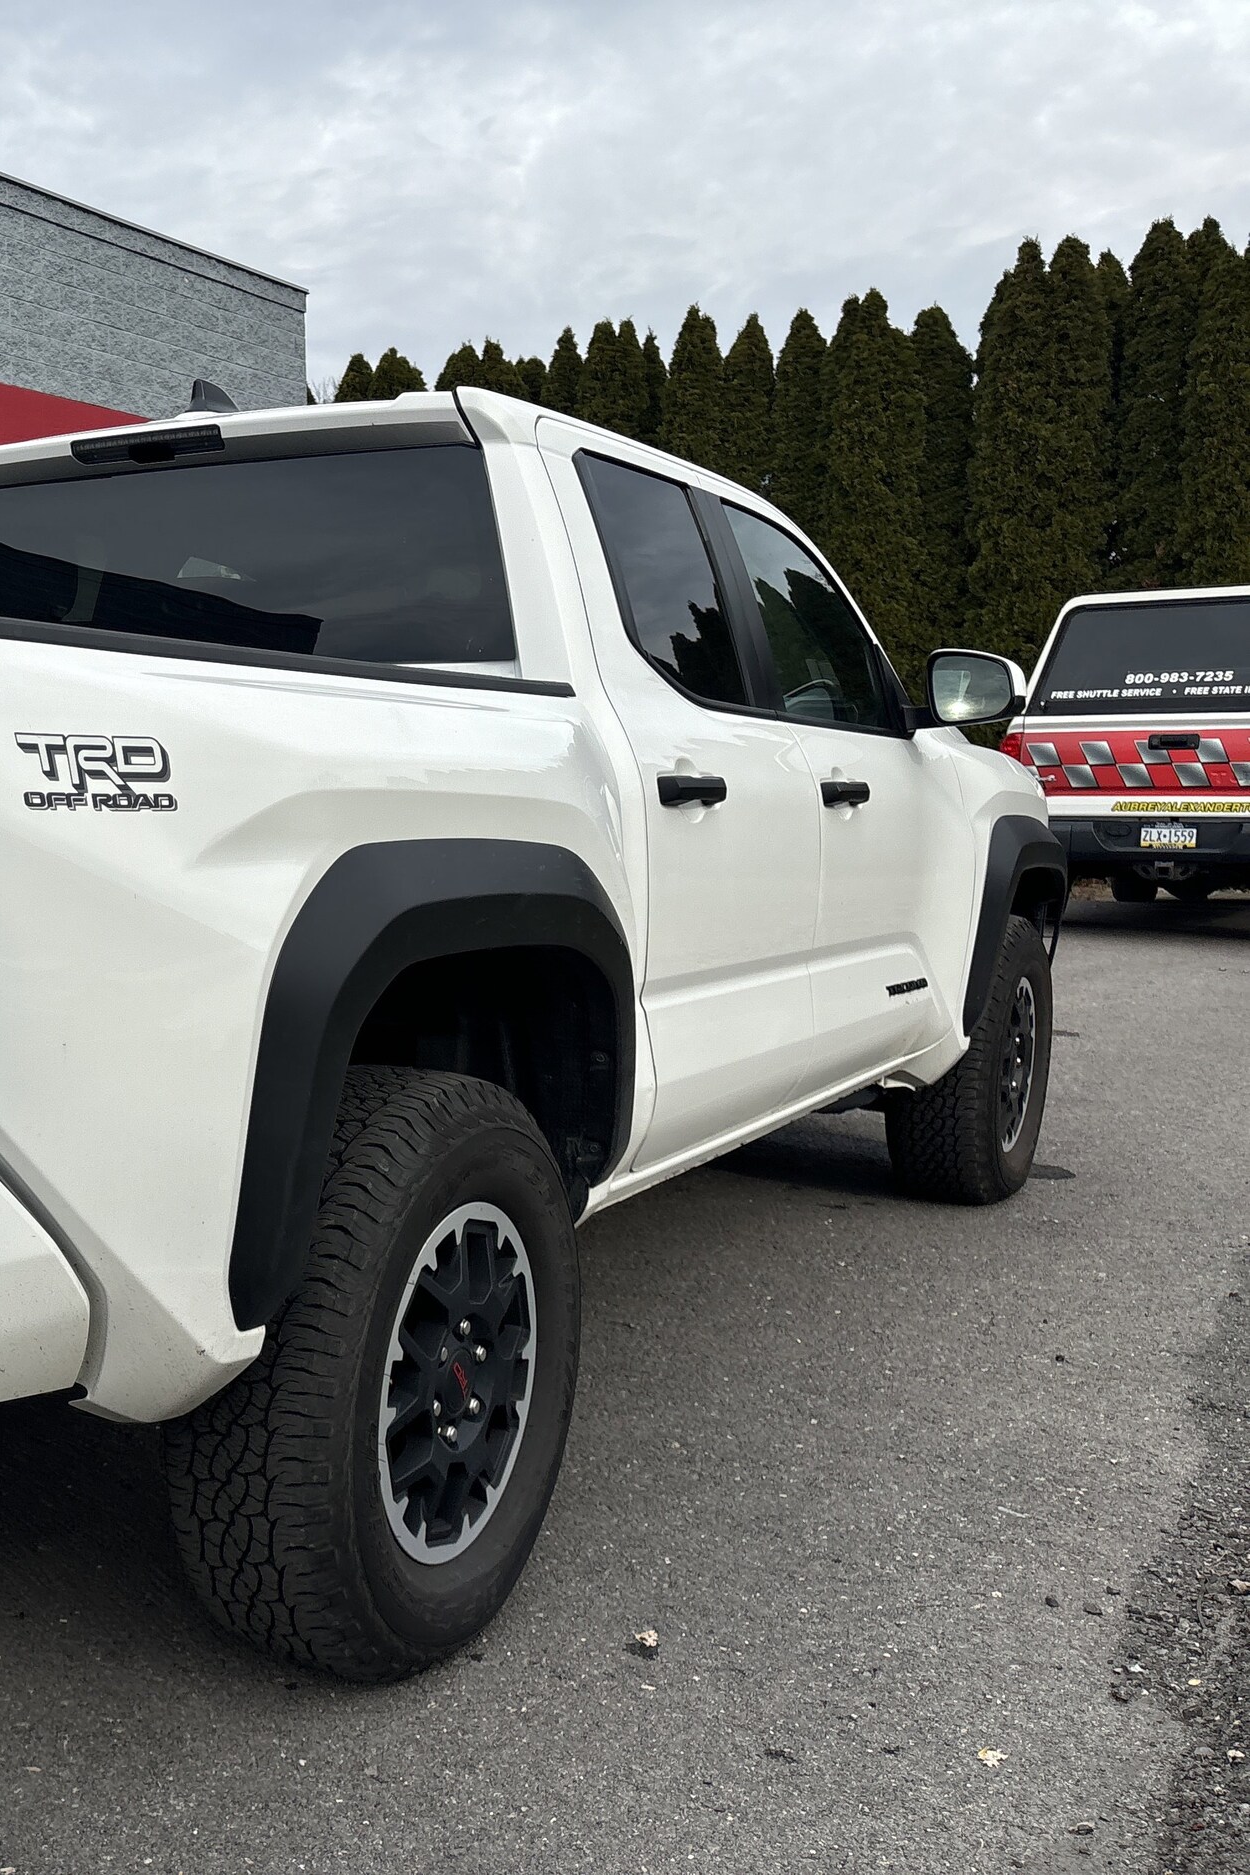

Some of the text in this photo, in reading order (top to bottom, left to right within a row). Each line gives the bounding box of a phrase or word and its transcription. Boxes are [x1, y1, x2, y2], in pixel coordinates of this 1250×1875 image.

[1125, 671, 1234, 684] 800-983-7235
[1051, 690, 1075, 700] FREE
[1076, 689, 1119, 699] SHUTTLE
[1121, 687, 1162, 697] SERVICE
[1184, 686, 1210, 696] FREE
[1212, 686, 1243, 695] STATE
[14, 732, 171, 794] TRD
[23, 791, 178, 811] OFF ROAD
